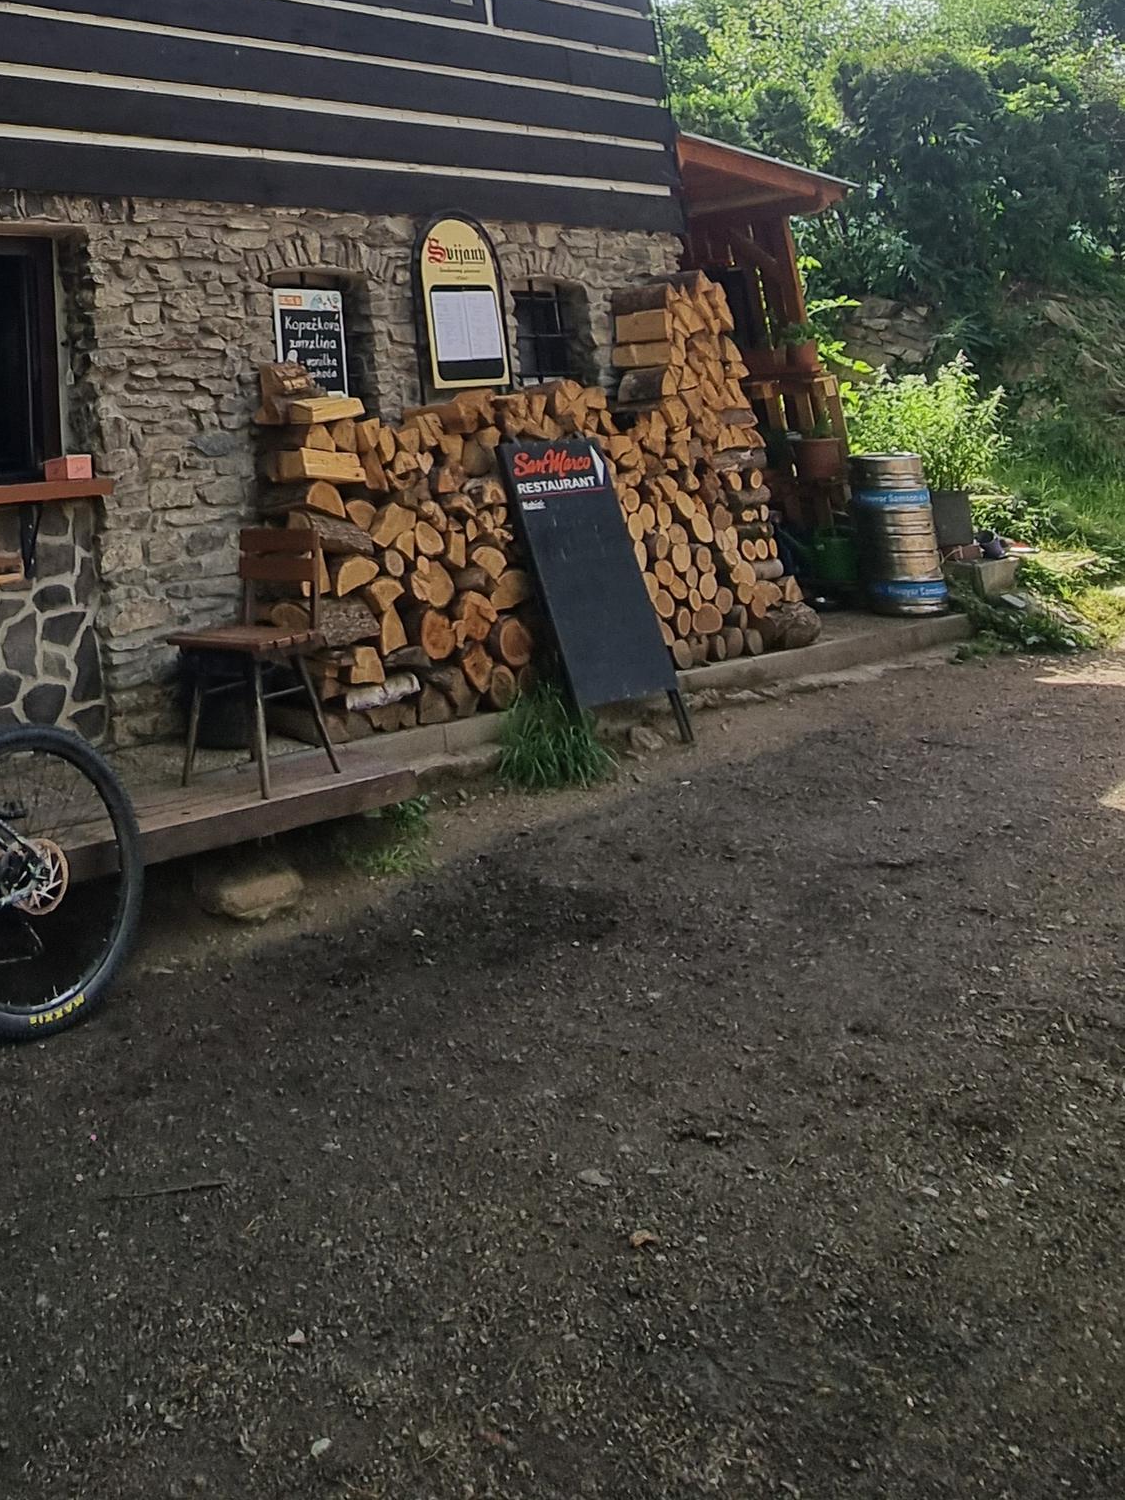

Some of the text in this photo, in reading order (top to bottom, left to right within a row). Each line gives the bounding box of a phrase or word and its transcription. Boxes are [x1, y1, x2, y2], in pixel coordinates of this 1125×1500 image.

[427, 237, 486, 266] Svijany
[289, 334, 337, 350] zmrzlina
[516, 475, 596, 495] RESTAURANT
[29, 992, 86, 1026] MAXXIS
